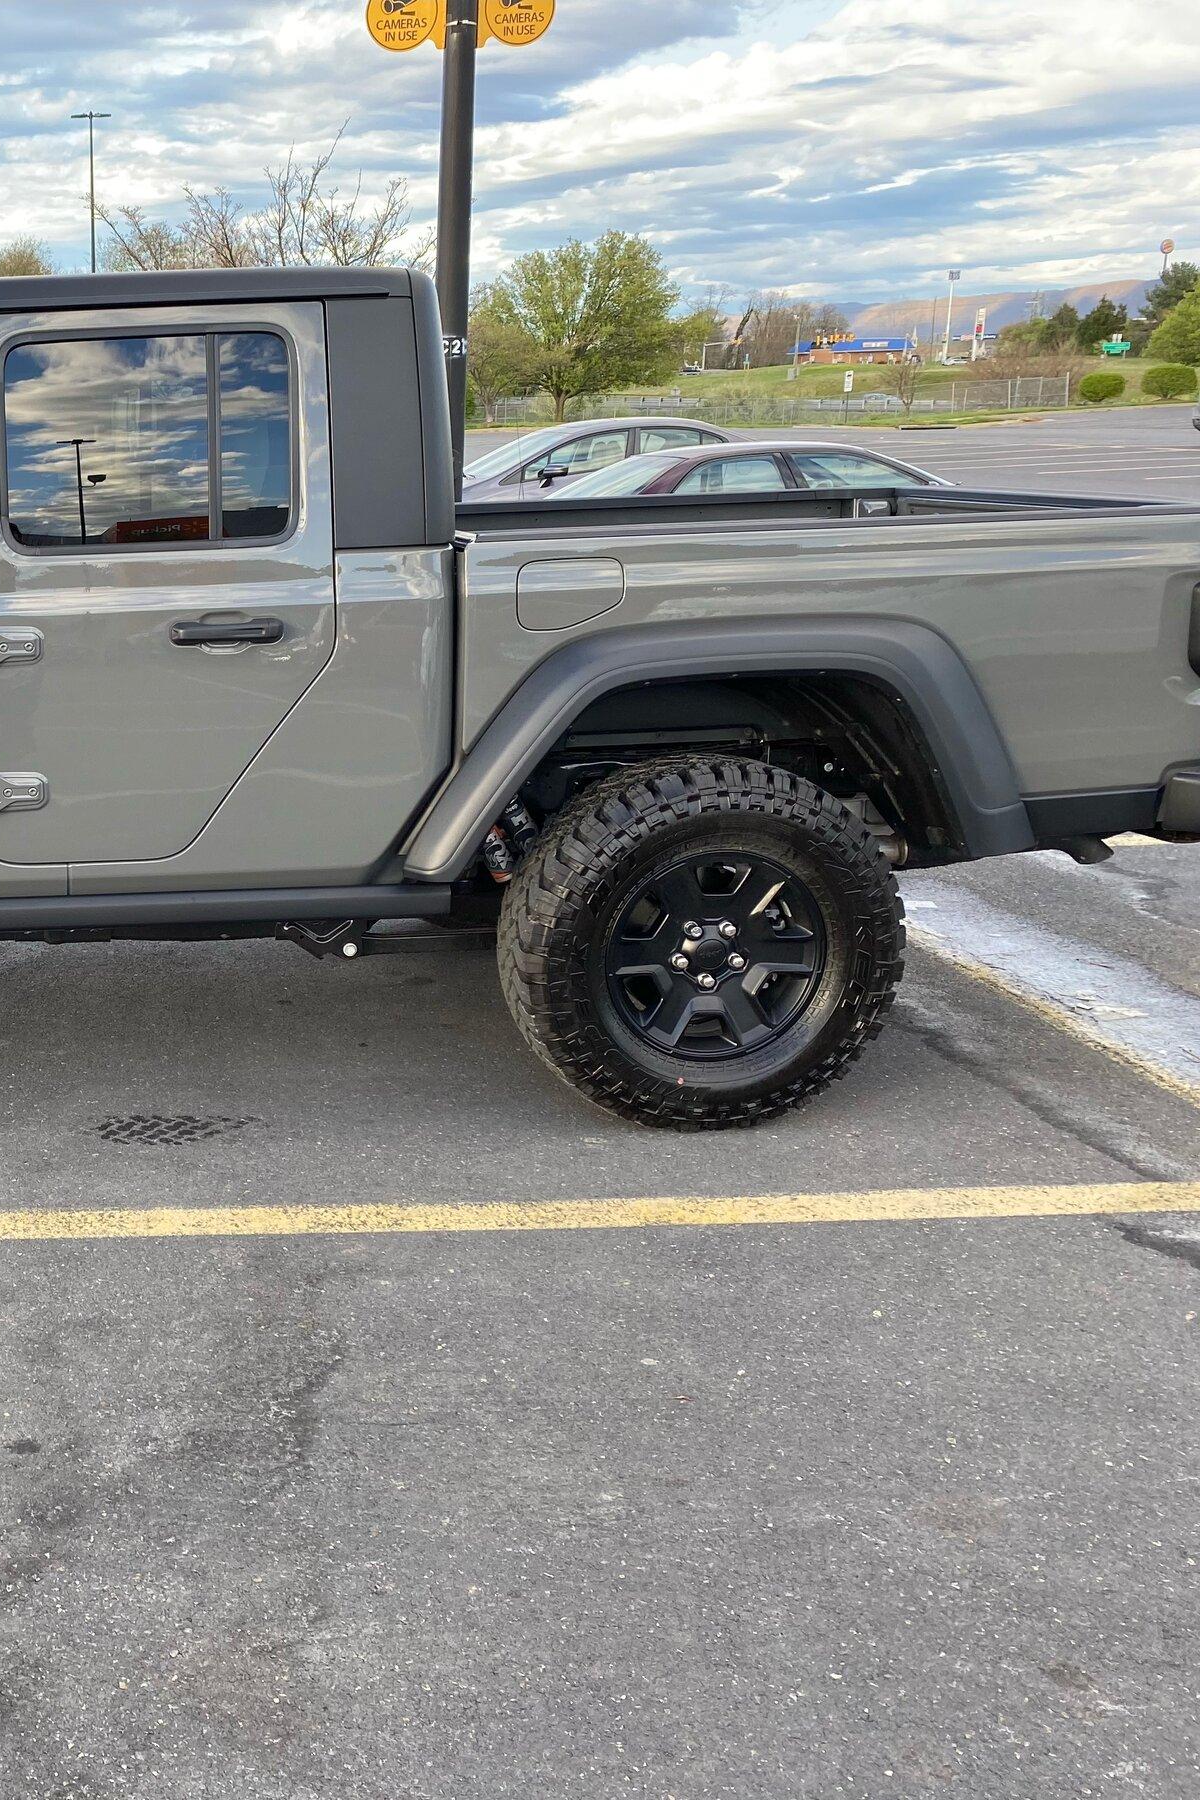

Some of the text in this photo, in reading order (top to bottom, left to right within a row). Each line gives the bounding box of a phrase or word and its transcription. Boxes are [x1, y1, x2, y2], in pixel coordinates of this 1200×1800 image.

[376, 17, 428, 31] CAMERAS
[494, 12, 545, 25] CAMERAS
[503, 24, 536, 36] IN USE
[384, 31, 418, 42] IN USE
[504, 803, 519, 814] Jeep
